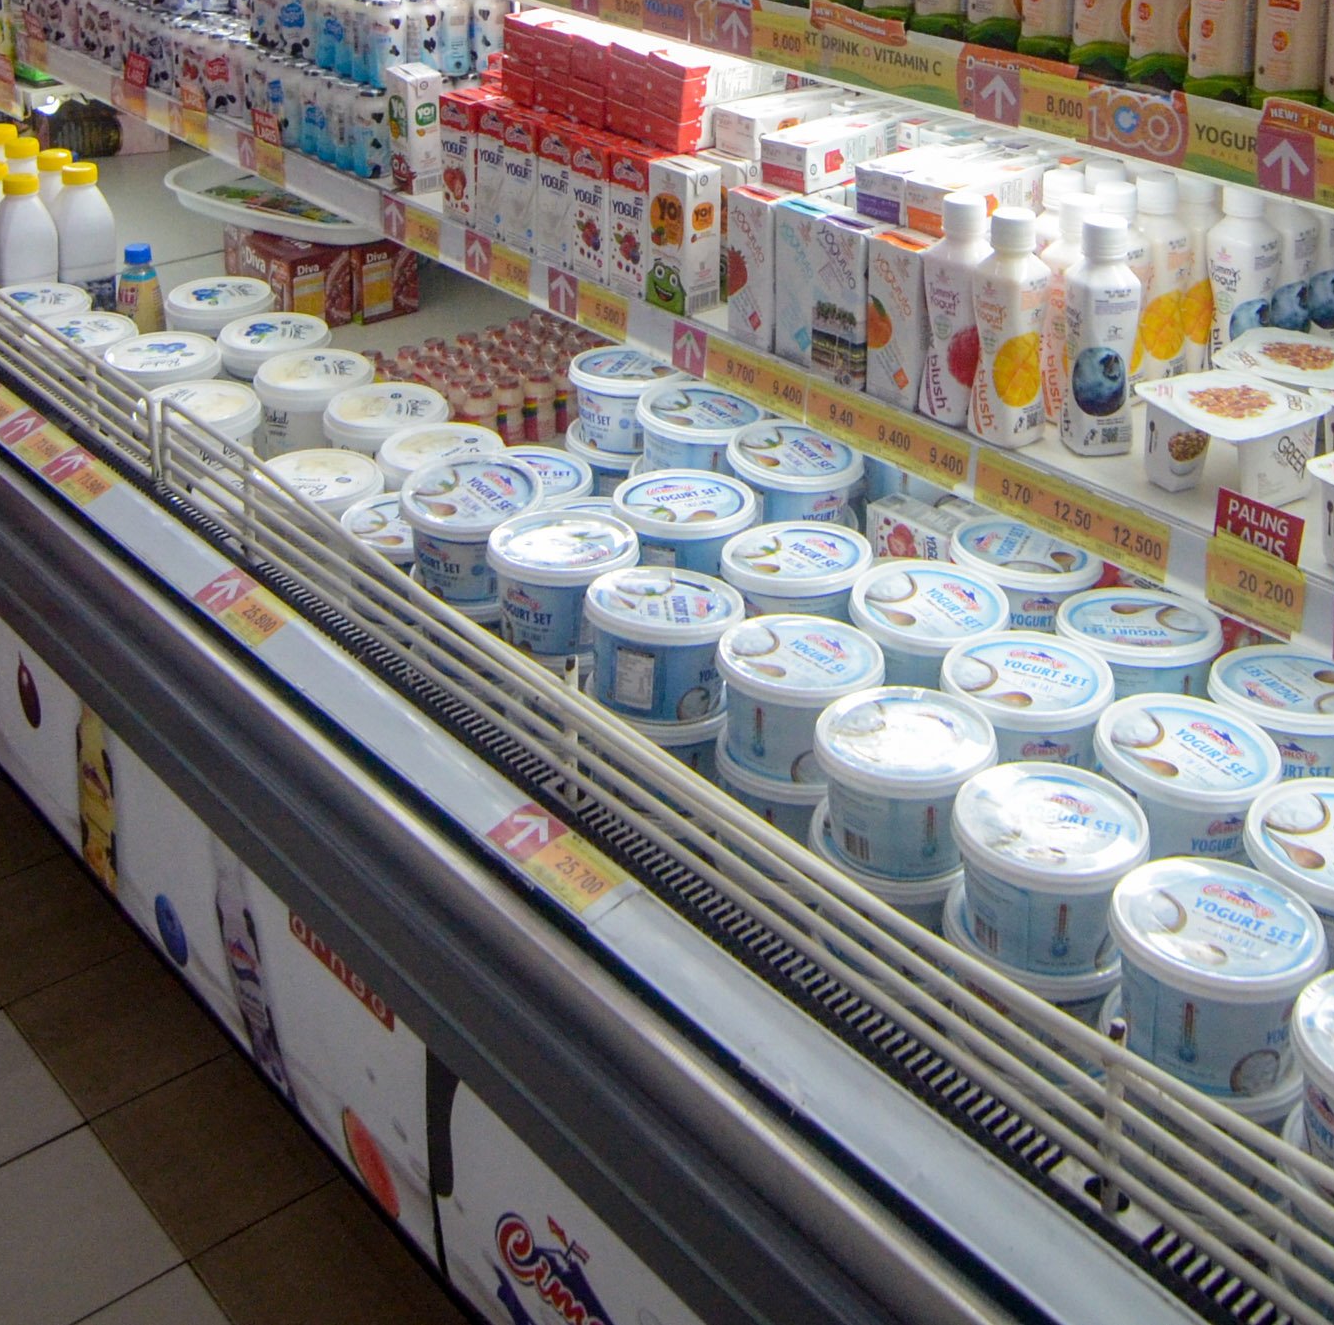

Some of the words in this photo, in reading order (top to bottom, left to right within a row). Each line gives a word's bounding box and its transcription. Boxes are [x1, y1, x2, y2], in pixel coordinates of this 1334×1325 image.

[821, 36, 860, 58] DRINK
[874, 46, 929, 74] VITAMIN
[1046, 94, 1084, 120] 8,000
[1270, 107, 1299, 124] NEW!
[1195, 122, 1259, 153] YOGUR
[574, 187, 602, 207] YOGURT
[612, 199, 643, 221] YOGURT
[653, 490, 700, 504] YOGURT
[1227, 498, 1289, 537] PALING
[790, 542, 821, 561] YOGURT
[1113, 525, 1162, 562] 12,500
[925, 587, 962, 620] YOGURT
[1237, 569, 1294, 608] 20,200
[1003, 657, 1059, 680] YOGURT
[1062, 674, 1091, 688] SET
[1177, 728, 1230, 767] YOGURT
[1231, 759, 1254, 780] SET
[1194, 896, 1264, 934] YOGURT
[1267, 925, 1302, 949] SET
